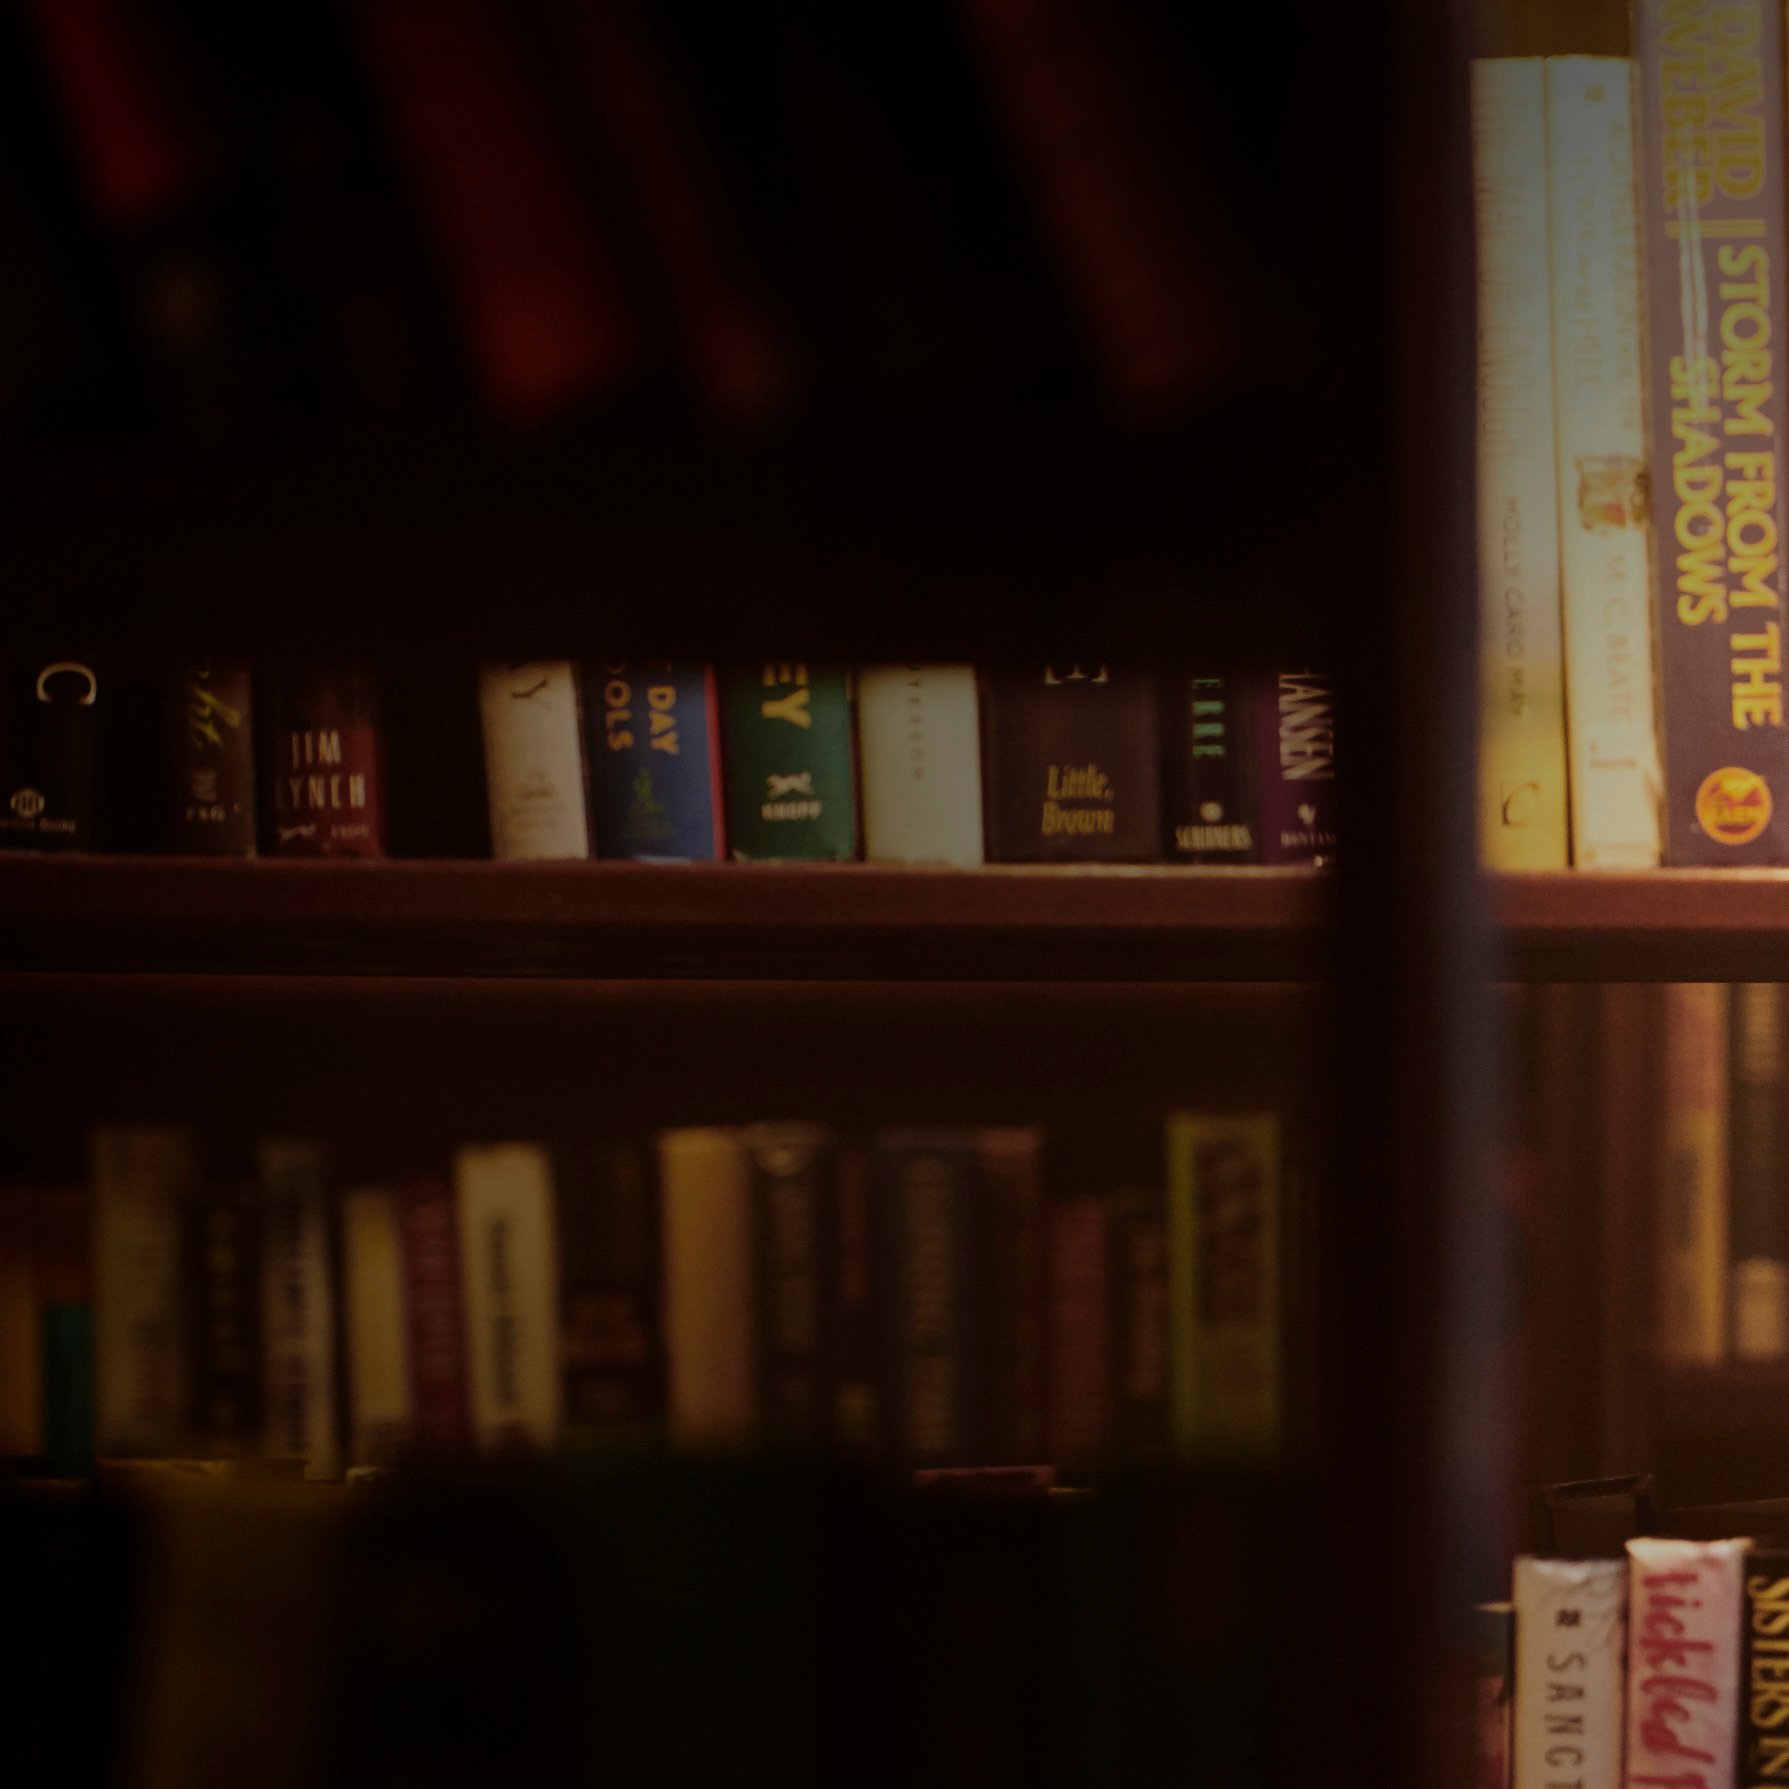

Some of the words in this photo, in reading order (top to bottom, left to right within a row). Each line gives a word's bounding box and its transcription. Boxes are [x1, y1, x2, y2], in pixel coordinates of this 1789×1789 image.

[1658, 0, 1709, 205] WEBER
[1713, 3, 1766, 197] DAVID
[1720, 245, 1773, 439] STORM
[1667, 354, 1723, 626] SHADOWS
[1724, 453, 1776, 605] FROM
[1501, 497, 1519, 579] MOLLY
[1503, 587, 1523, 660] CARO
[646, 685, 682, 757] DAY
[1729, 622, 1782, 731] THE
[291, 729, 342, 772] JIM
[1047, 761, 1115, 802] Little,
[1041, 799, 1115, 838] Brown
